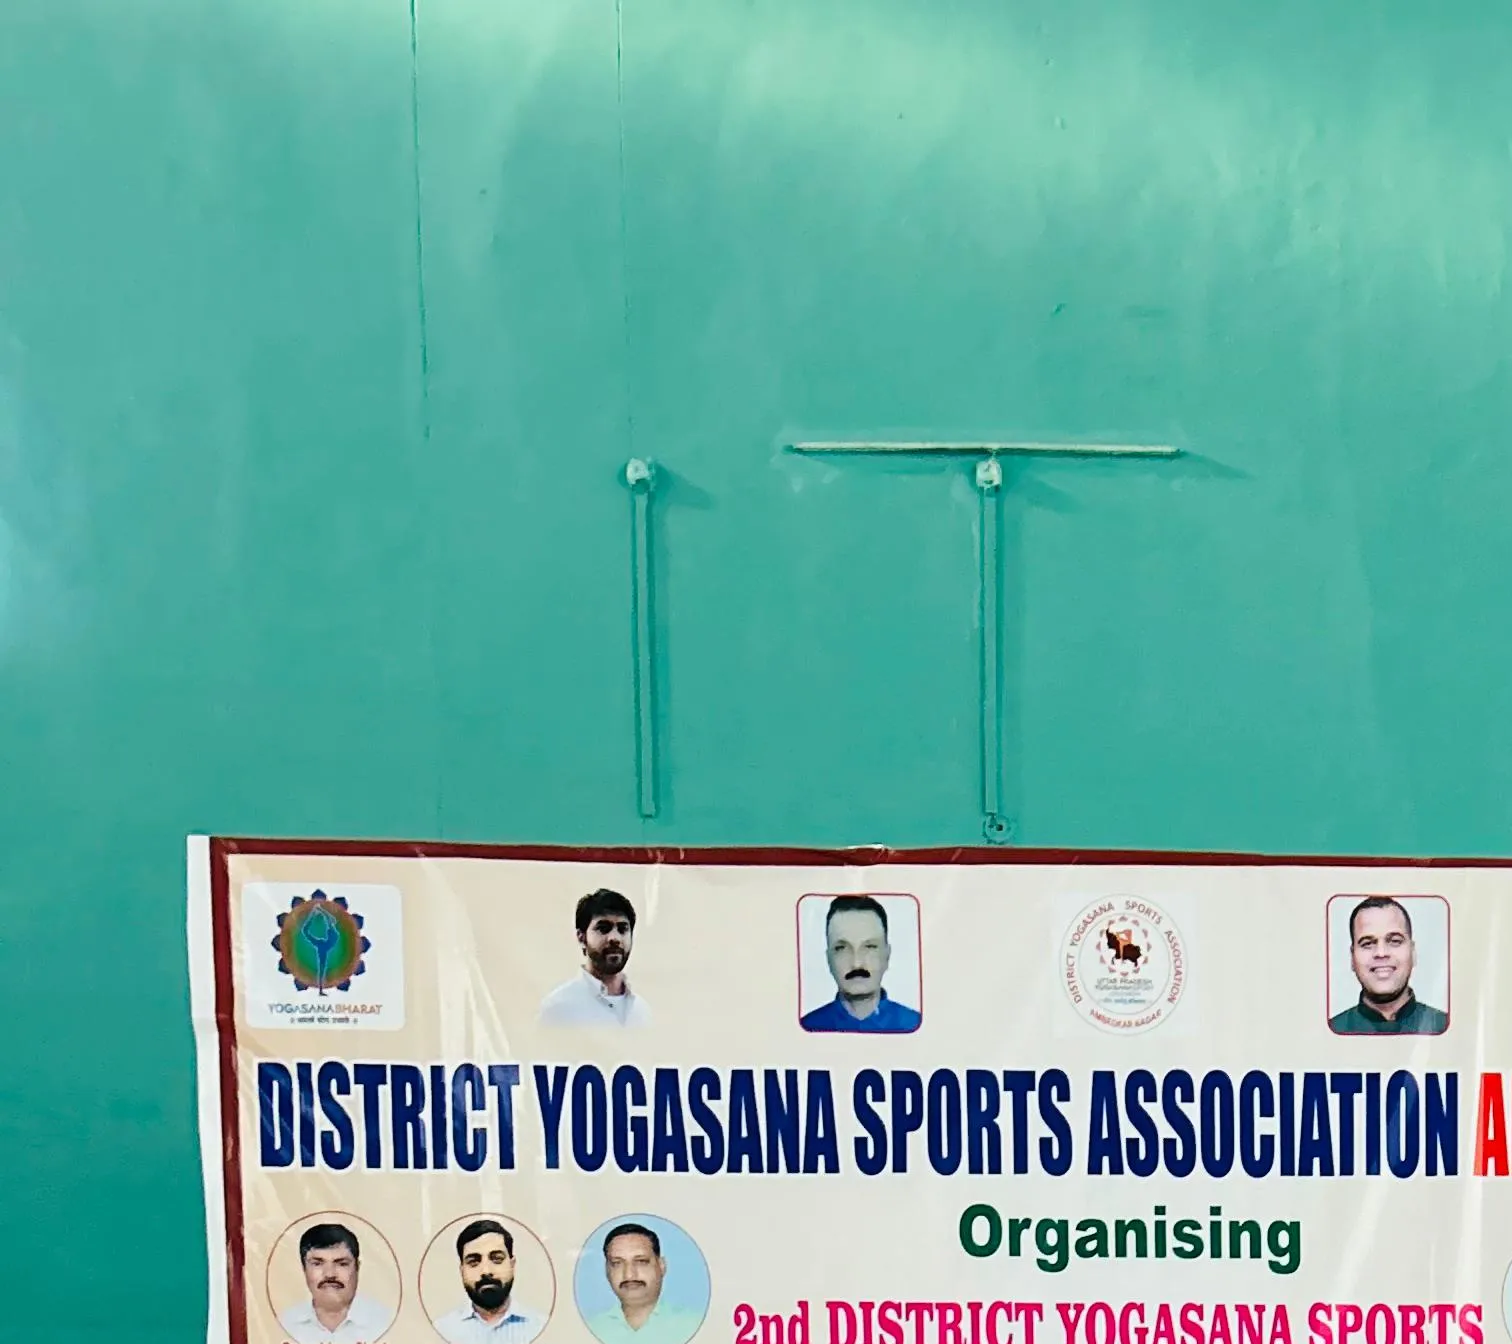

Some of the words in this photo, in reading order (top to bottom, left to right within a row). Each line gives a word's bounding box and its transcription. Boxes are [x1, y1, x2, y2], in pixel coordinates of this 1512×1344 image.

[257, 1061, 520, 1172] DISTRICT
[533, 1064, 840, 1175] YOGASANA
[852, 1068, 1073, 1177] SPORTS
[1087, 1069, 1458, 1179] ASSOCIATION
[958, 1204, 1302, 1275] Organising
